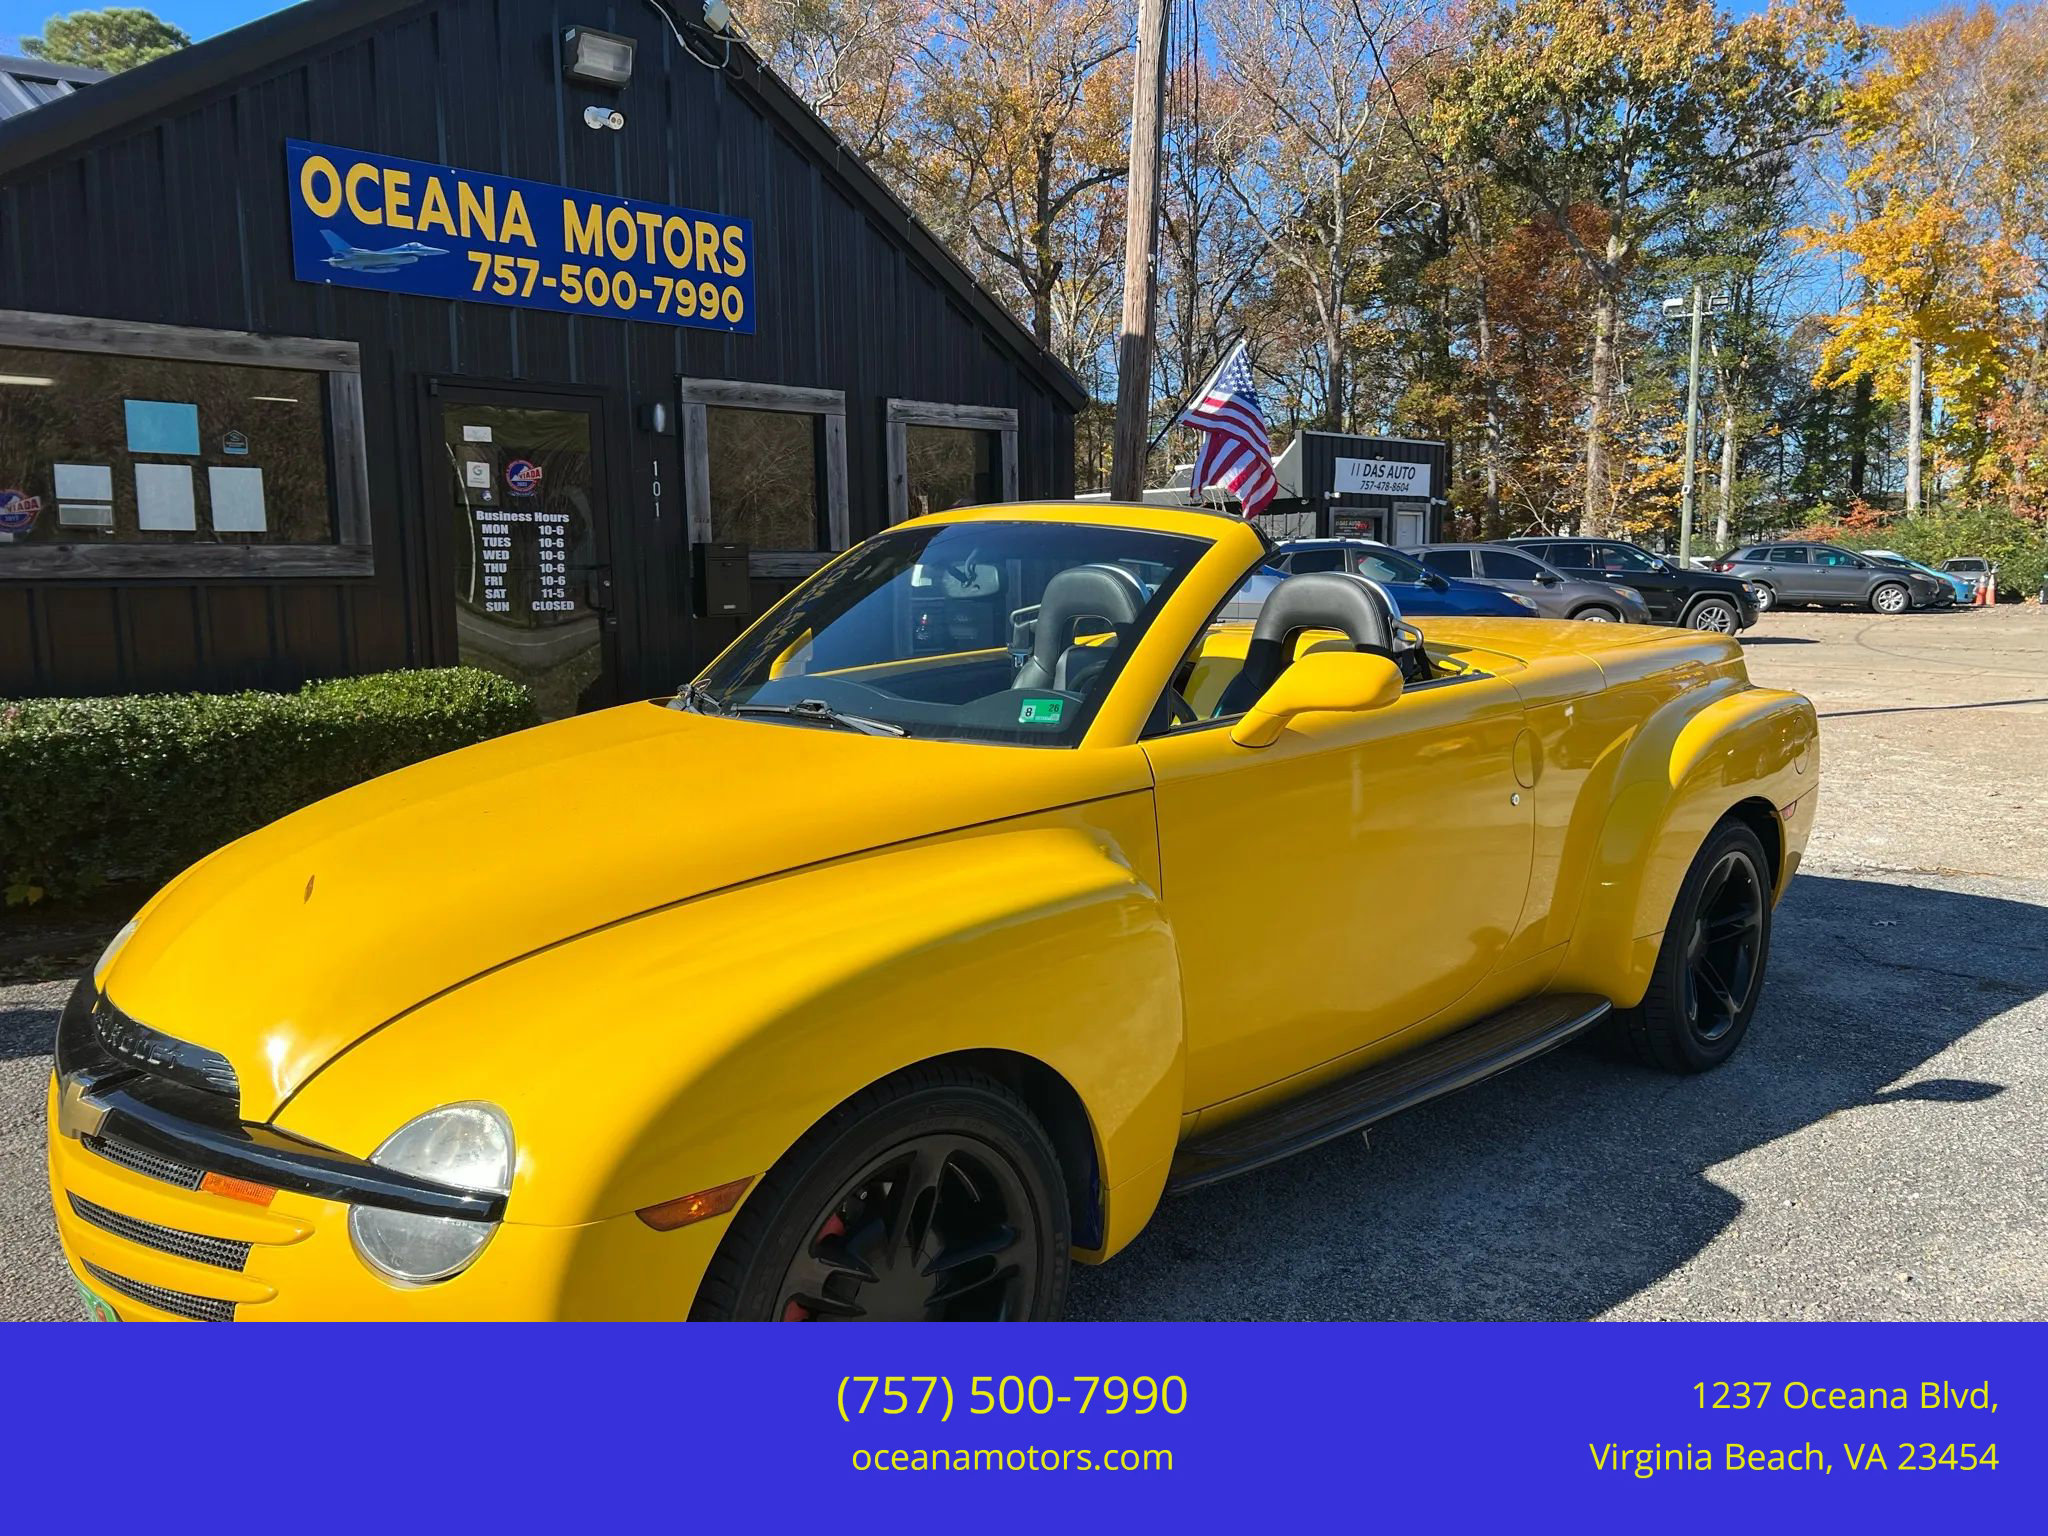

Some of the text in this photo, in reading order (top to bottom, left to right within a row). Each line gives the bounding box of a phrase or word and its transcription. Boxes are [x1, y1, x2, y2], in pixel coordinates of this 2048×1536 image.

[301, 155, 746, 278] OCEANA MOTORS
[467, 250, 745, 323] 757-500-7990
[1363, 463, 1385, 478] DAS
[1387, 465, 1416, 480] AUTO
[476, 510, 570, 522] Business Hours
[481, 523, 564, 535] MON 10-6
[482, 536, 565, 548] TUES 10-6
[483, 550, 565, 560] WED 10-6
[483, 563, 565, 573] THU 10-6
[484, 576, 566, 586] FRI 10-6
[485, 588, 565, 599] SAT 11-5
[485, 601, 575, 612] SUN CLOSED
[1025, 707, 1033, 717] 8
